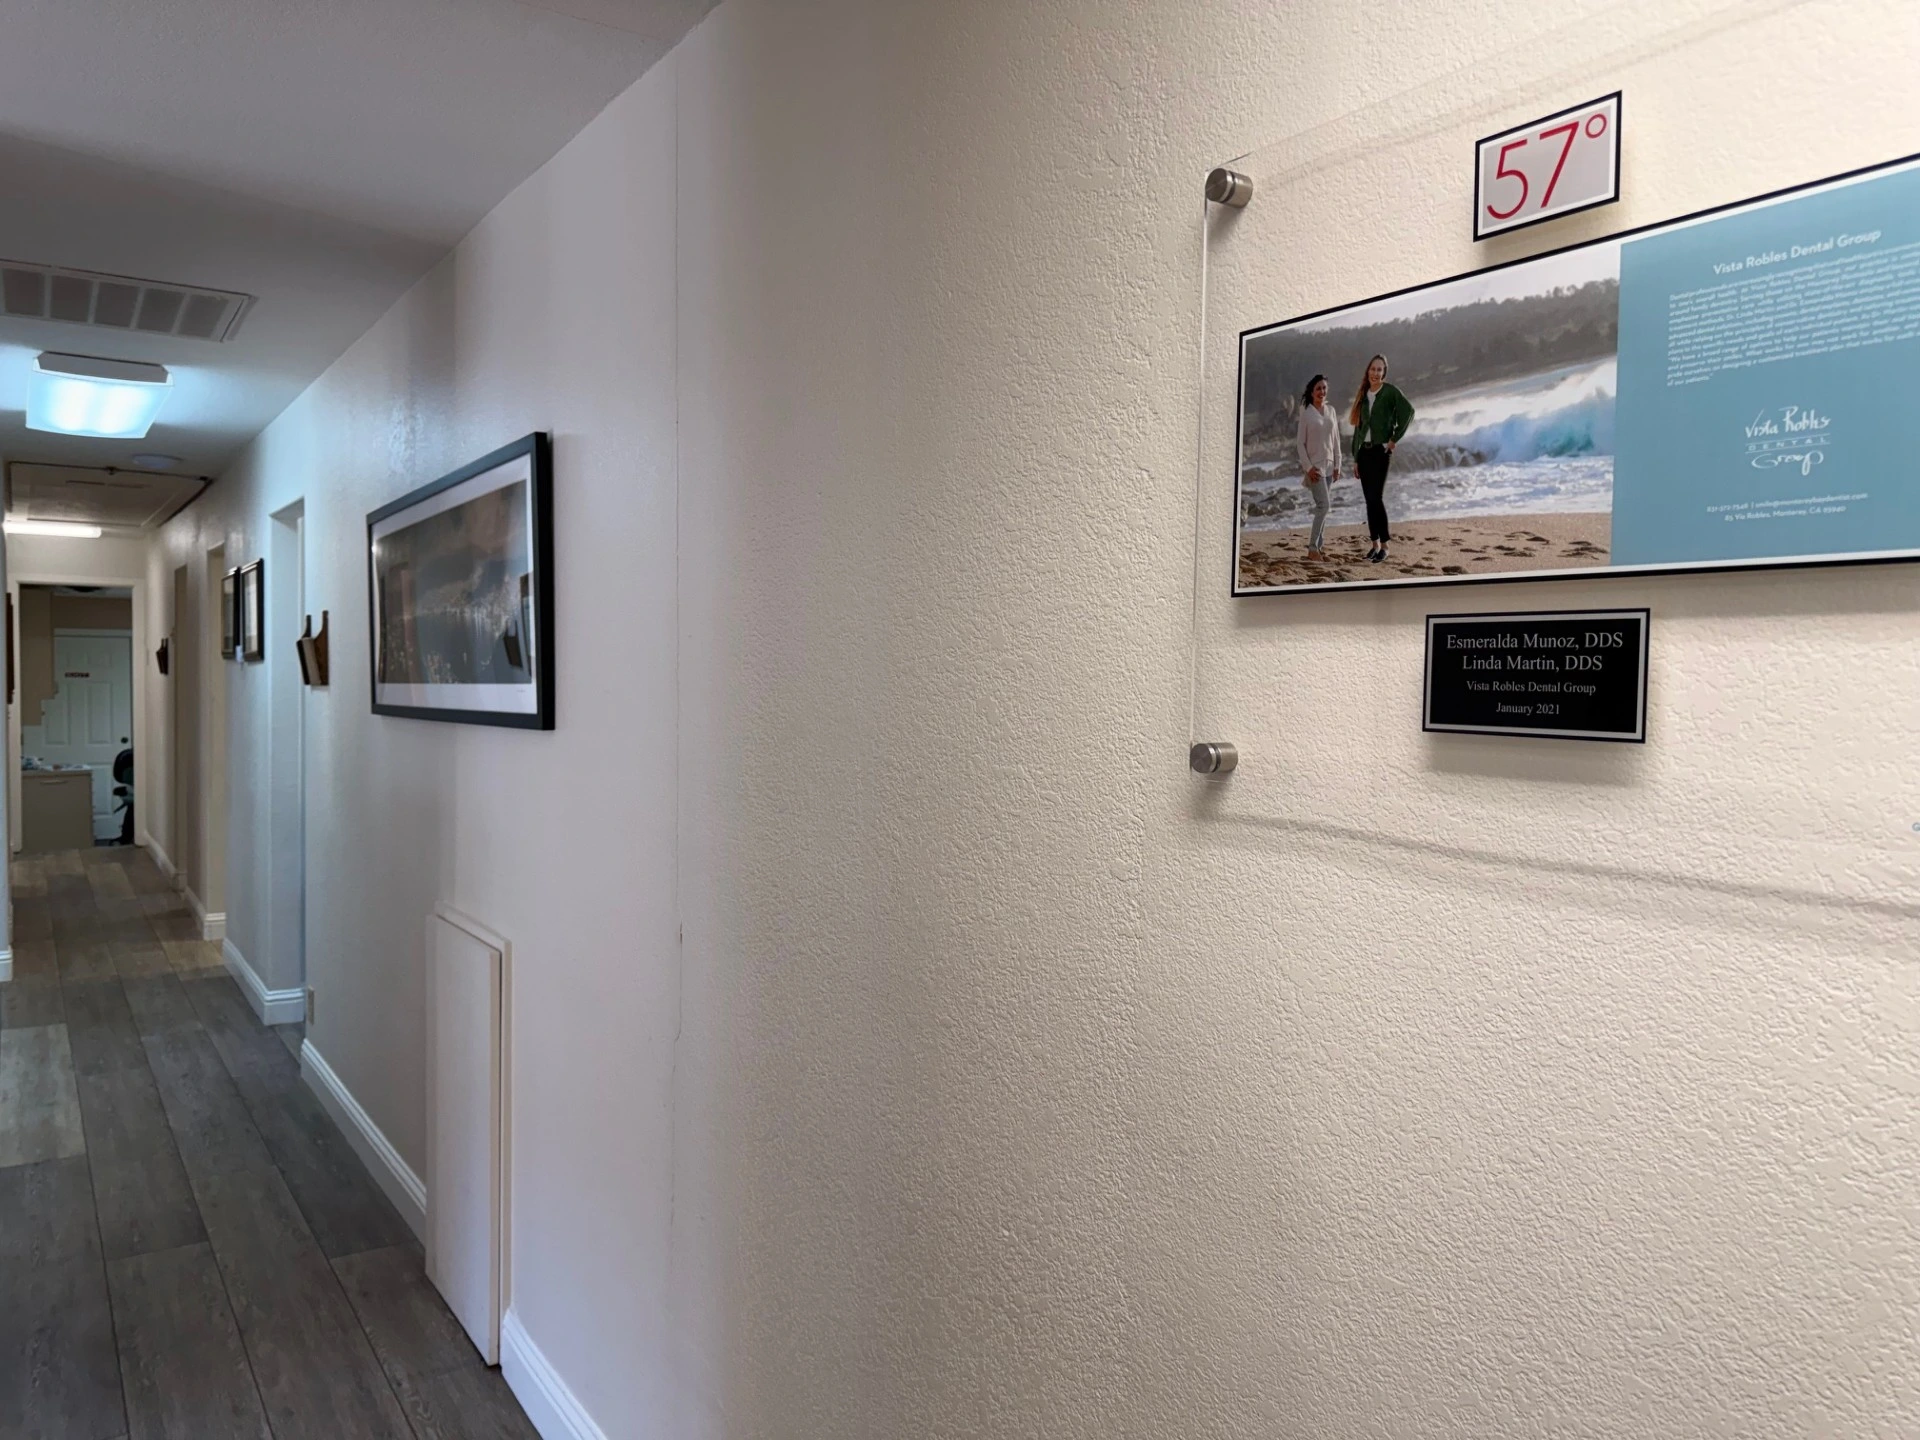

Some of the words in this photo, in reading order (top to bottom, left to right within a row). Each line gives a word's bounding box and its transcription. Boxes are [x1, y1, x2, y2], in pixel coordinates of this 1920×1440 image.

[1714, 262, 1743, 275] Vista
[1746, 252, 1787, 268] Robles
[1791, 238, 1834, 258] Dental
[1837, 230, 1881, 247] Group
[1745, 409, 1779, 438] Vista
[1779, 406, 1831, 432] Robles
[1749, 438, 1826, 451] DENTAL
[1752, 451, 1824, 475] Group
[1447, 633, 1518, 649] Esmeralda
[1524, 633, 1579, 650] Munoz,
[1585, 632, 1623, 648] DDS
[1463, 655, 1502, 670] Linda
[1507, 655, 1559, 672] Martin,
[1565, 655, 1602, 671] DDS
[1466, 681, 1490, 691] Vista
[1493, 681, 1525, 692] Robles
[1529, 682, 1560, 692] Dental
[1564, 682, 1596, 695] Group
[1496, 702, 1533, 715] January
[1536, 704, 1560, 714] 2021
